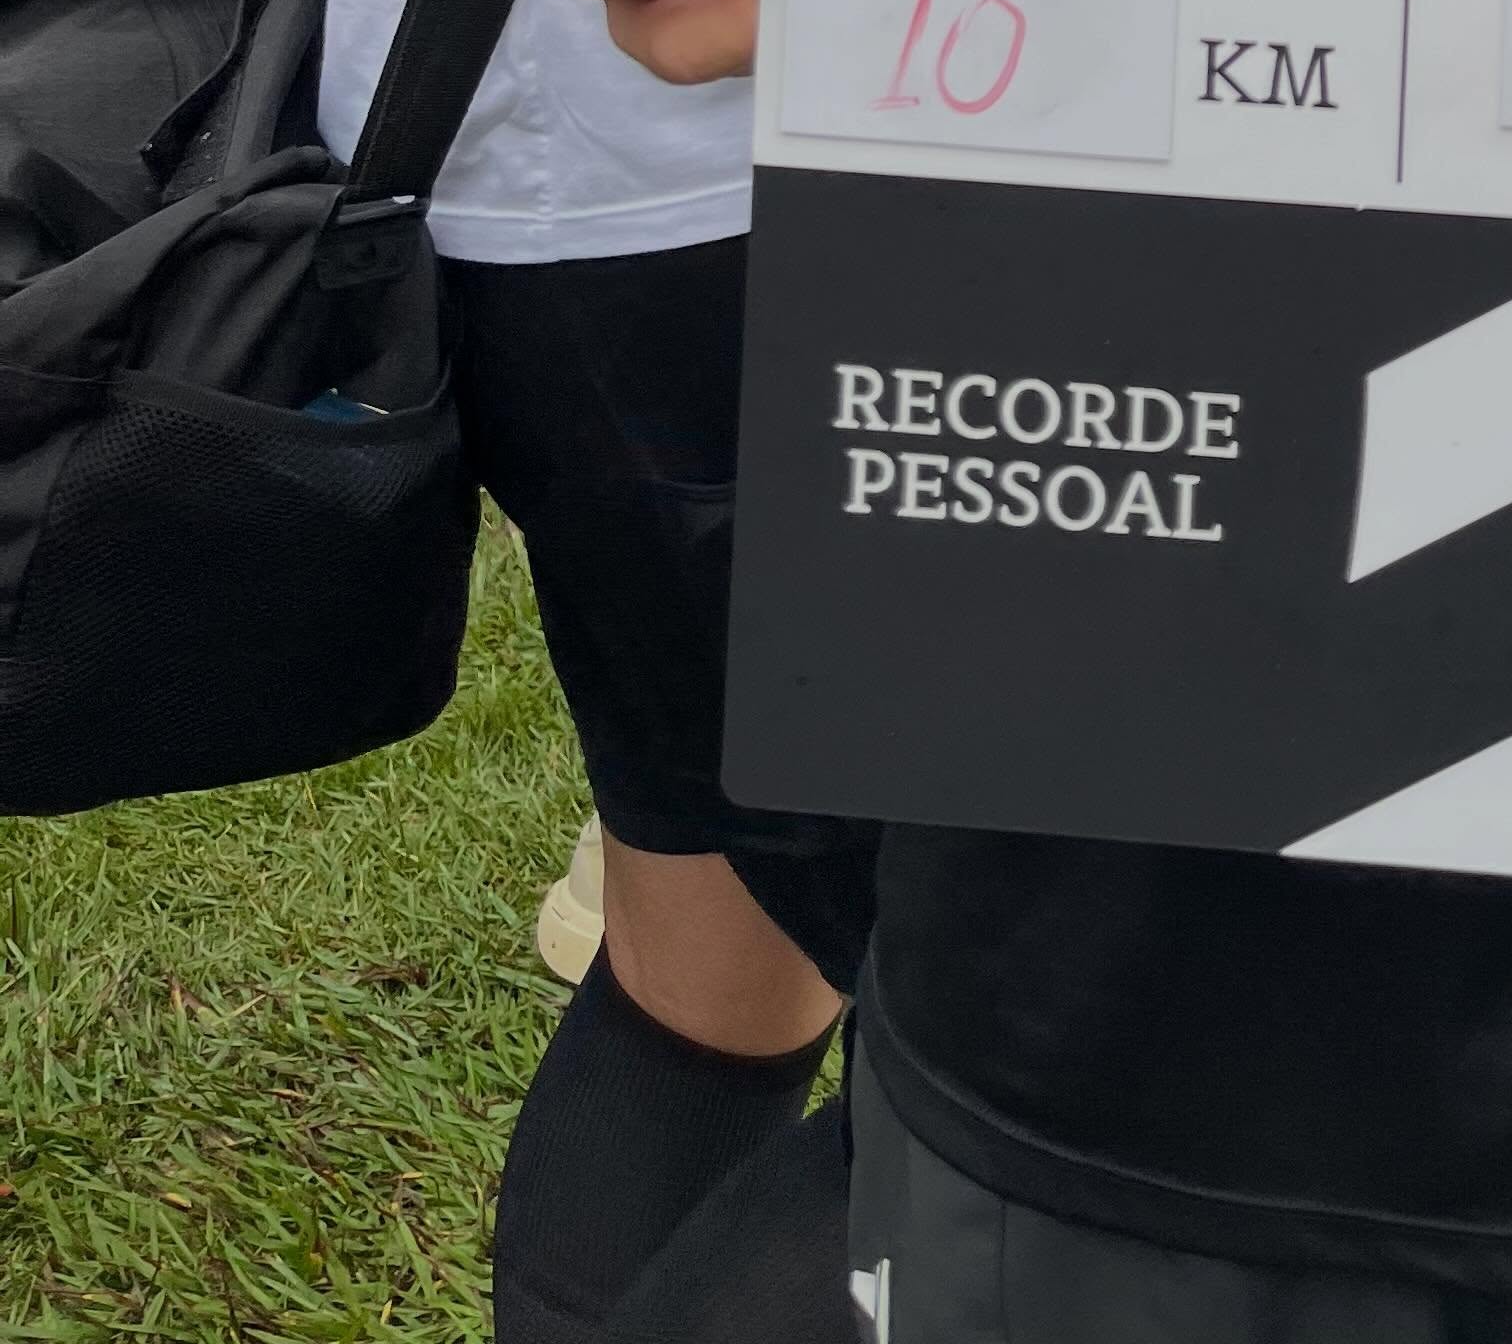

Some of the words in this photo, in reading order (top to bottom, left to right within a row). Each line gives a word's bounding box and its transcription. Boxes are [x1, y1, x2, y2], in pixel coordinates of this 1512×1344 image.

[1197, 38, 1338, 109] KM
[831, 363, 1241, 459] RECORDE
[843, 448, 1223, 542] PESSOAL
